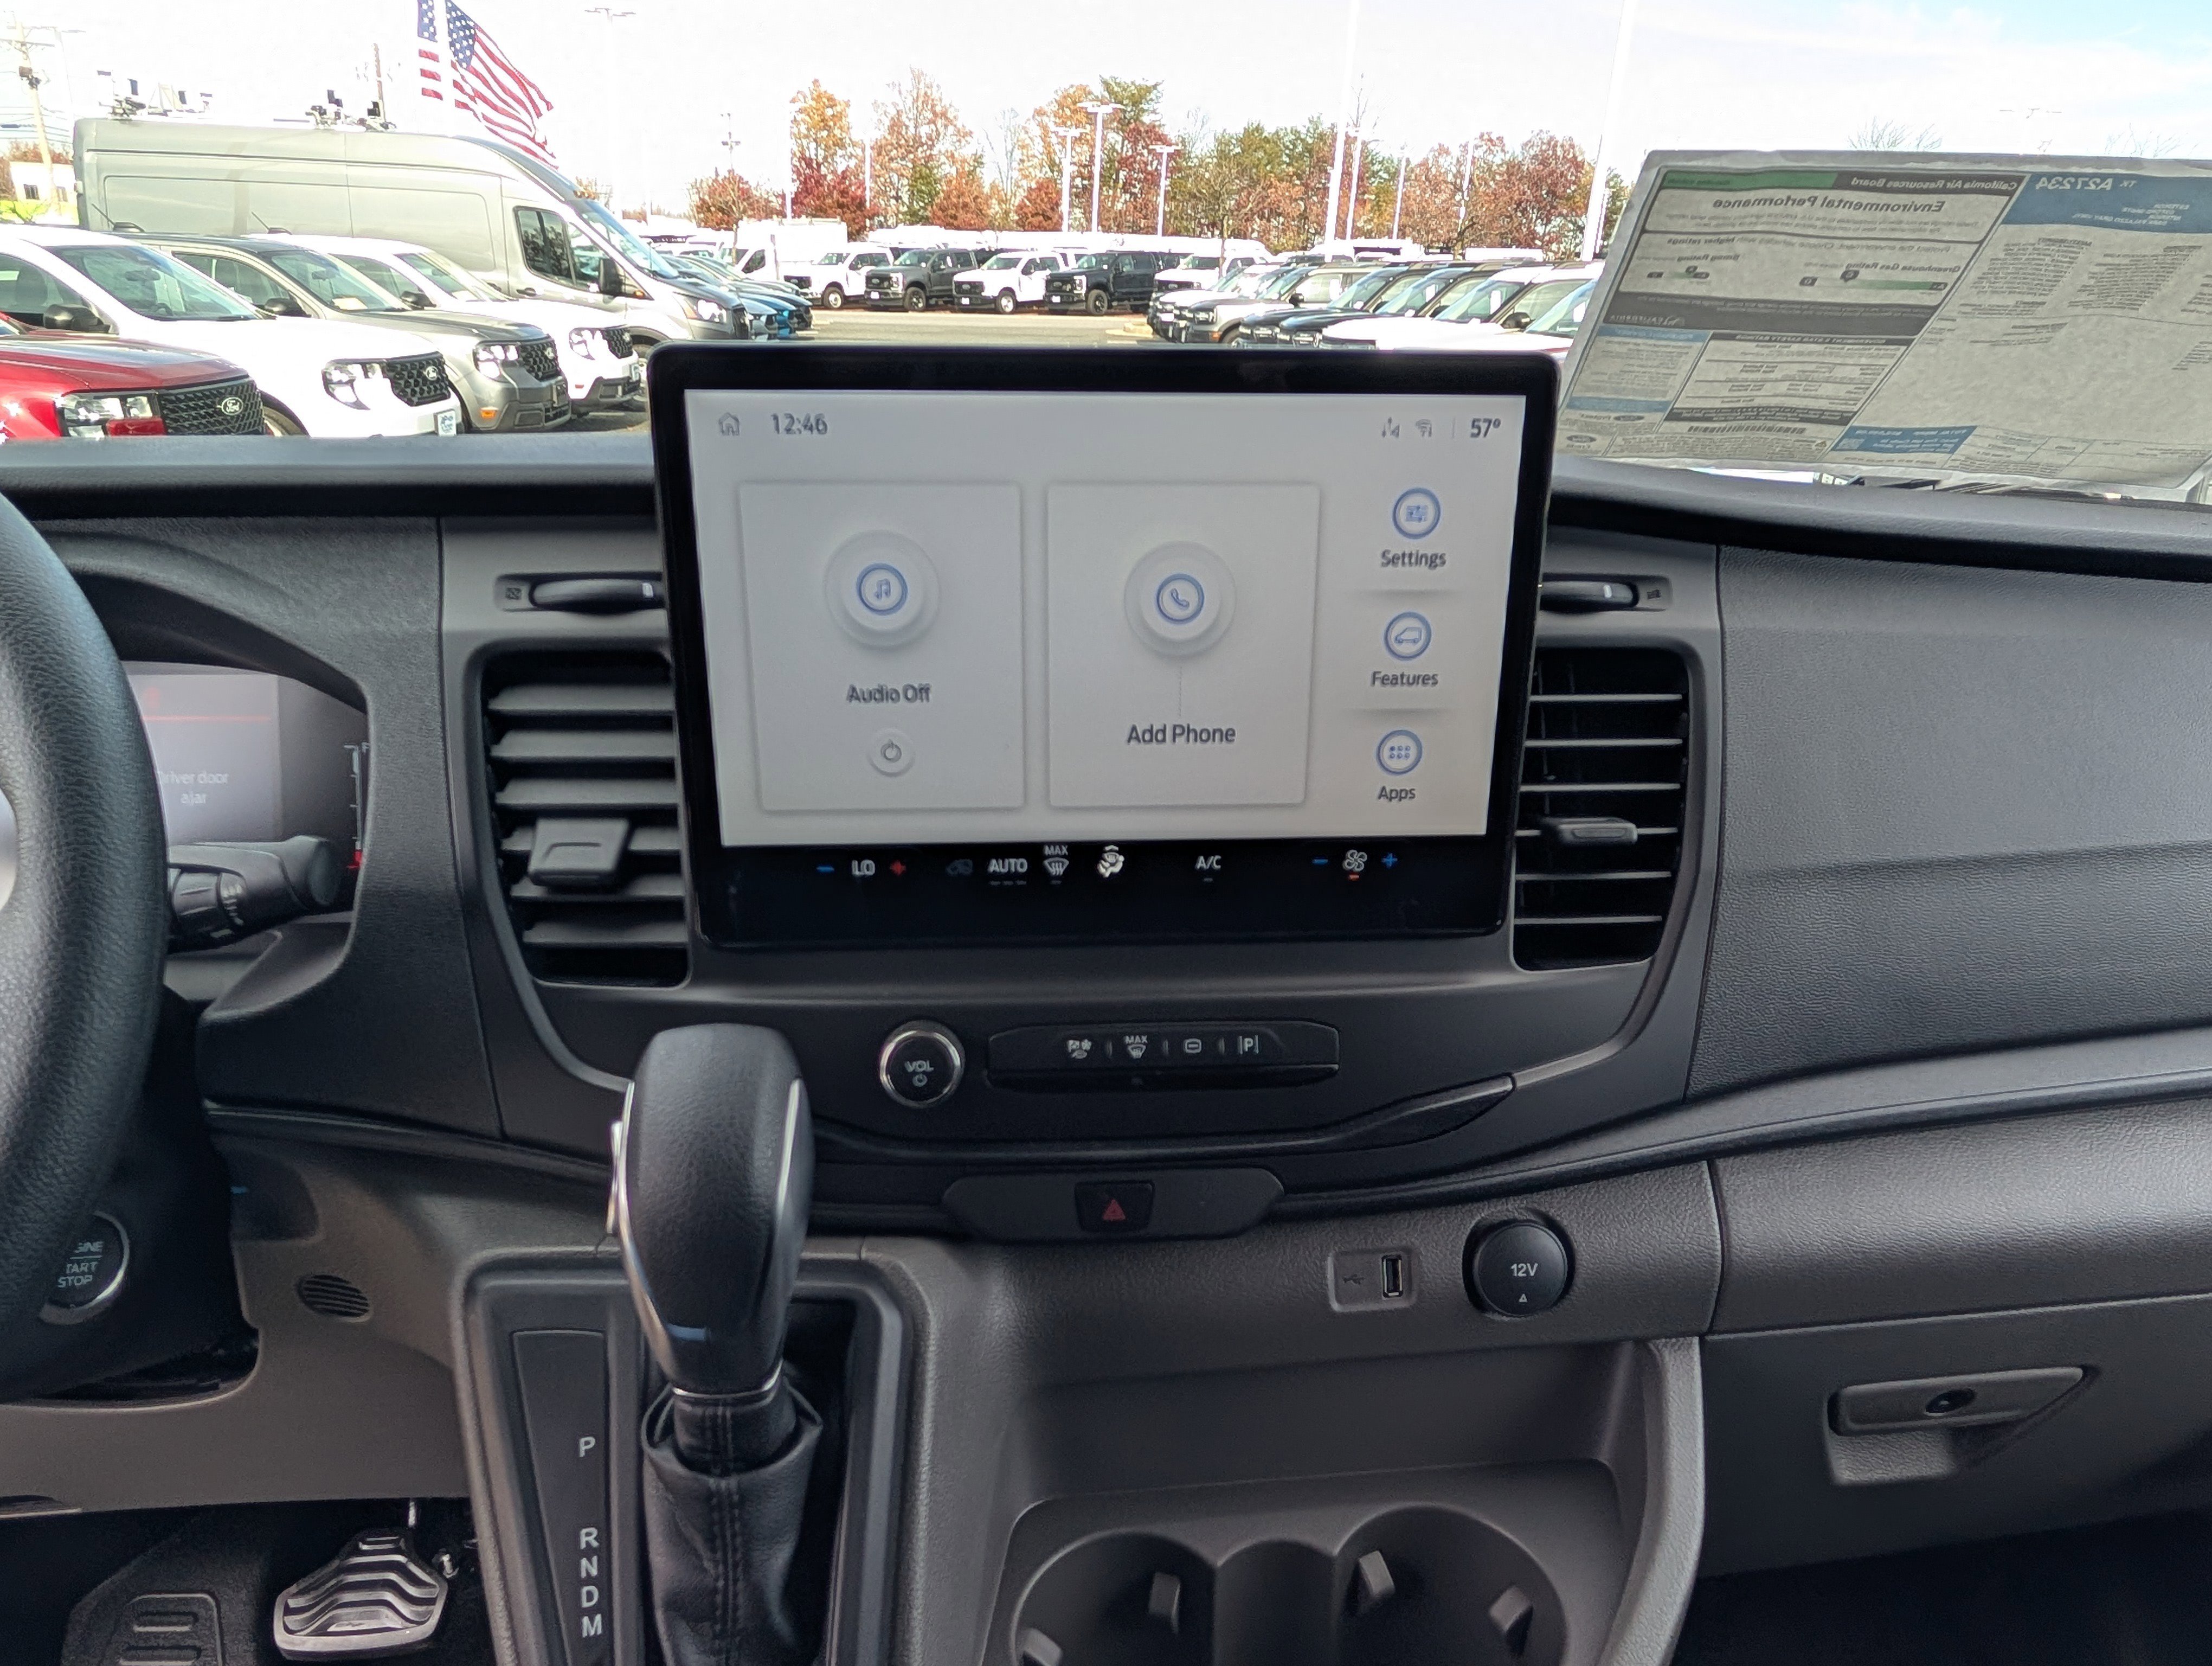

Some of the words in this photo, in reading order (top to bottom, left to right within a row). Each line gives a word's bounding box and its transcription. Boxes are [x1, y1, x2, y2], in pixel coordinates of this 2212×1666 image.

[770, 413, 828, 434] 12:46
[1380, 550, 1446, 569] Settings
[1371, 671, 1439, 687] Features
[846, 683, 901, 703] Audio
[902, 683, 933, 703] Off
[1126, 724, 1167, 744] Add
[1172, 724, 1236, 744] Phone
[197, 770, 229, 784] door
[180, 791, 207, 806] ajar
[1377, 785, 1416, 803] Apps
[1044, 845, 1069, 856] MAX
[852, 860, 876, 877] LO
[988, 858, 1028, 874] AUTO
[1195, 855, 1221, 869] A/C
[1124, 1035, 1148, 1045] MAX
[904, 1060, 934, 1073] VOL
[65, 1261, 99, 1274] TART
[1510, 1263, 1539, 1277] 12V
[57, 1274, 93, 1288] STOP
[578, 1436, 596, 1458] P
[579, 1527, 600, 1549] R
[580, 1555, 598, 1579] N
[581, 1585, 599, 1609] D
[581, 1613, 602, 1638] M
